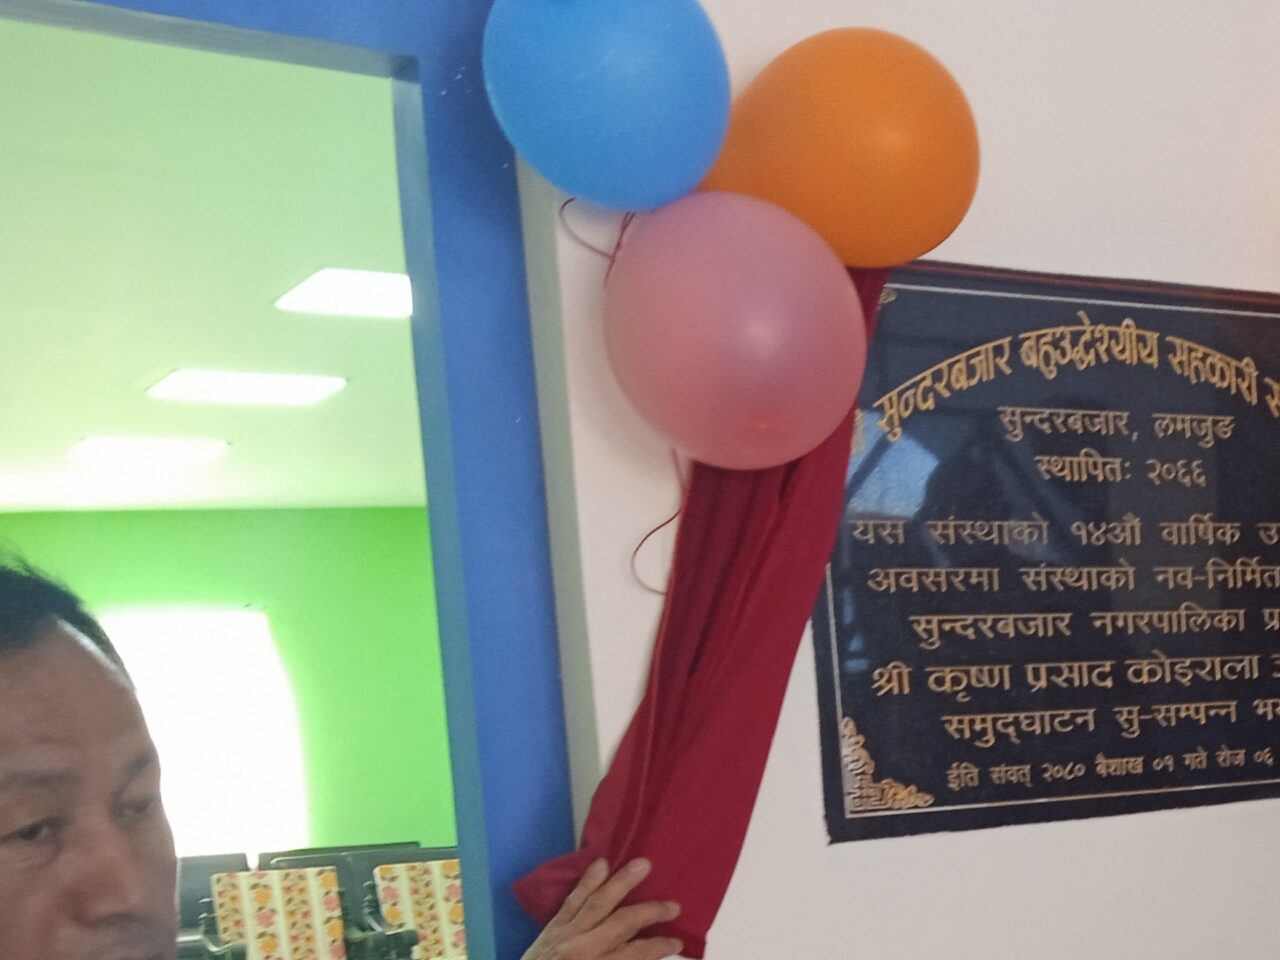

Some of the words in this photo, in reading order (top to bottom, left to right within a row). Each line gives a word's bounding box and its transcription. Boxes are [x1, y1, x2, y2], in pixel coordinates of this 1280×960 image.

[873, 336, 1013, 442] सुन्दरबजार
[1165, 336, 1259, 406] सहकारी
[1146, 458, 1206, 487] २०६६
[850, 519, 906, 545] यस
[927, 511, 1048, 545] संस्थाको
[1159, 513, 1241, 545] वार्षिक
[867, 567, 1000, 593] अवसरमा
[1019, 558, 1136, 591] संस्थाको
[1153, 556, 1280, 590] नव-निर्मित
[908, 612, 1073, 650] सुन्दरबजार
[1089, 602, 1246, 635] नगरपालिका
[871, 661, 912, 696] श्री
[924, 664, 1012, 702] कृष्ण
[1025, 660, 1116, 692] प्रसाद
[1124, 649, 1261, 687] कोइराला
[1113, 700, 1238, 738] सु-सम्पन्न
[1041, 761, 1087, 782] २०८०
